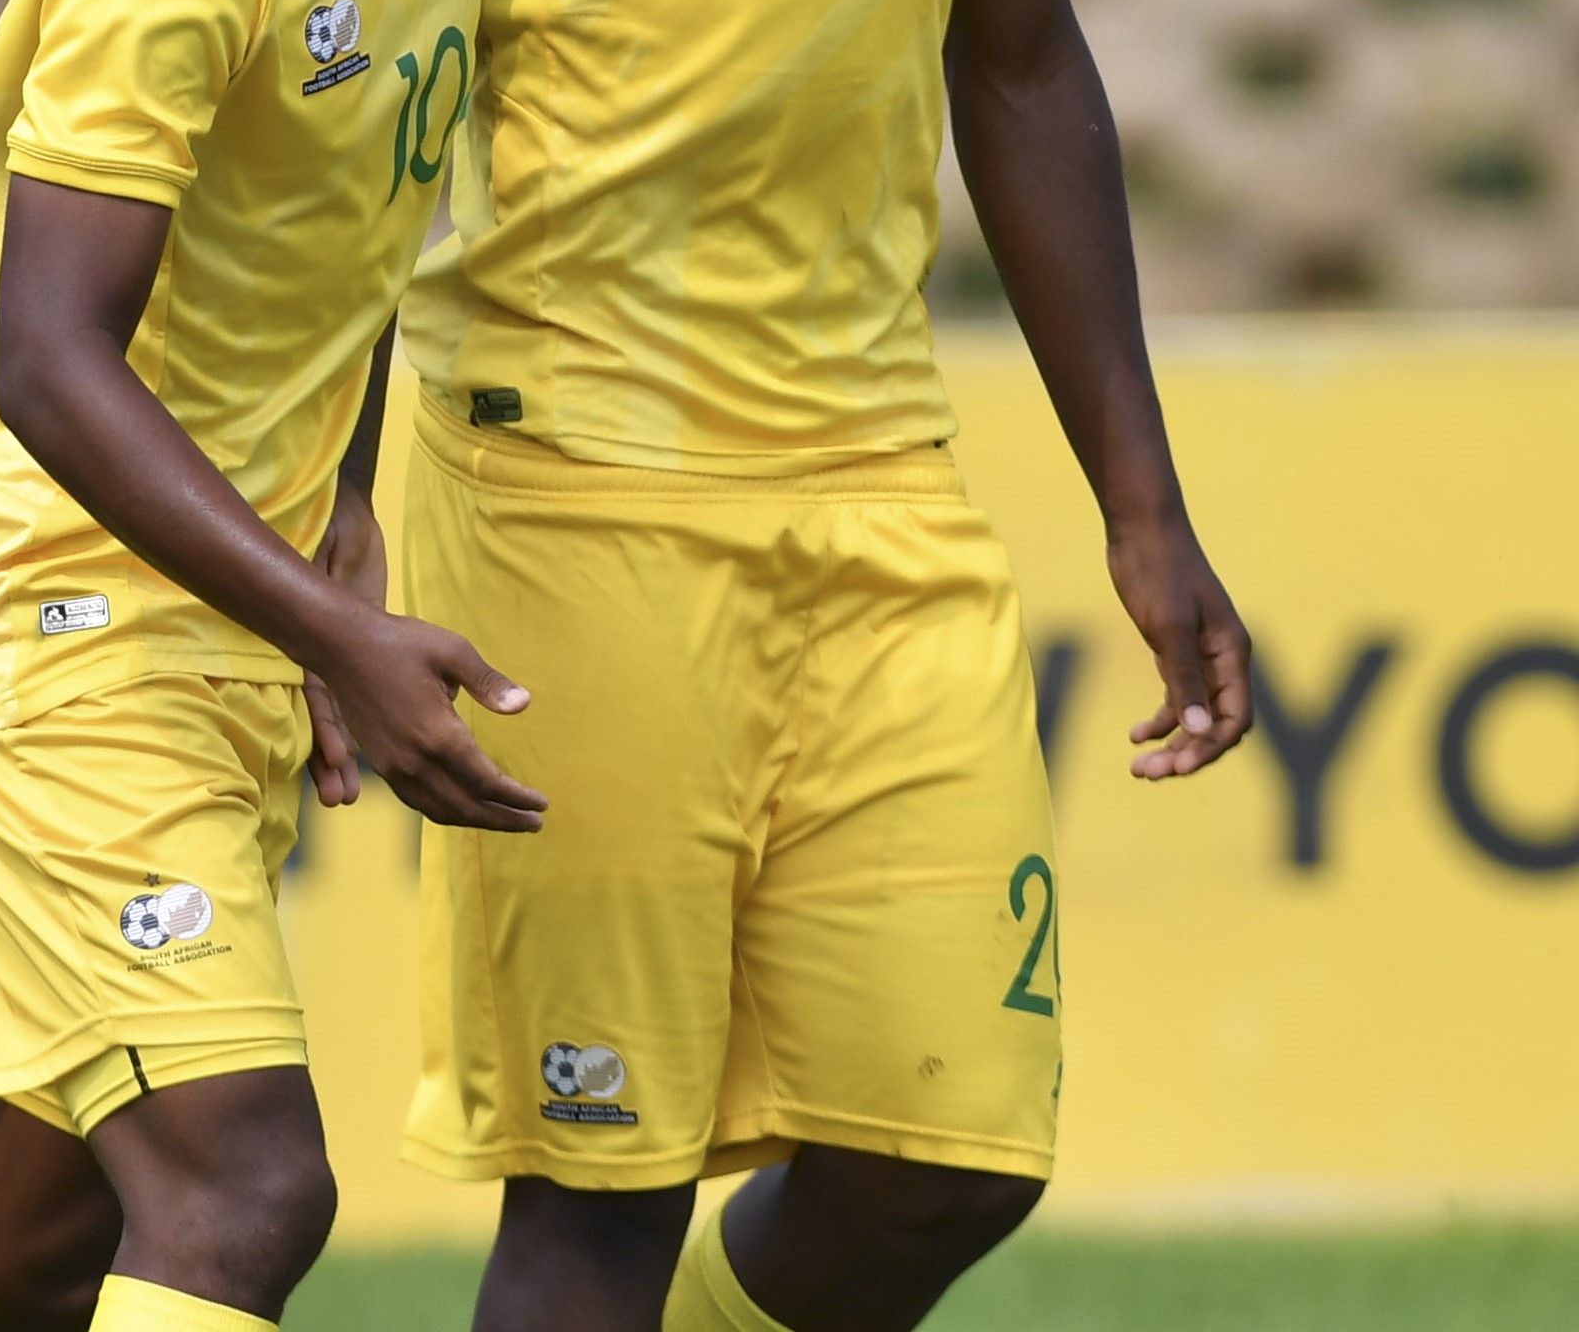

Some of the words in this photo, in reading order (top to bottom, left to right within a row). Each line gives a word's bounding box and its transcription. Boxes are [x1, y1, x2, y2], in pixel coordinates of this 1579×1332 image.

[386, 26, 468, 207] 10
[174, 940, 212, 955] AFRICAN
[174, 945, 232, 964] ASSOCIATION
[1002, 853, 1061, 1017] 2
